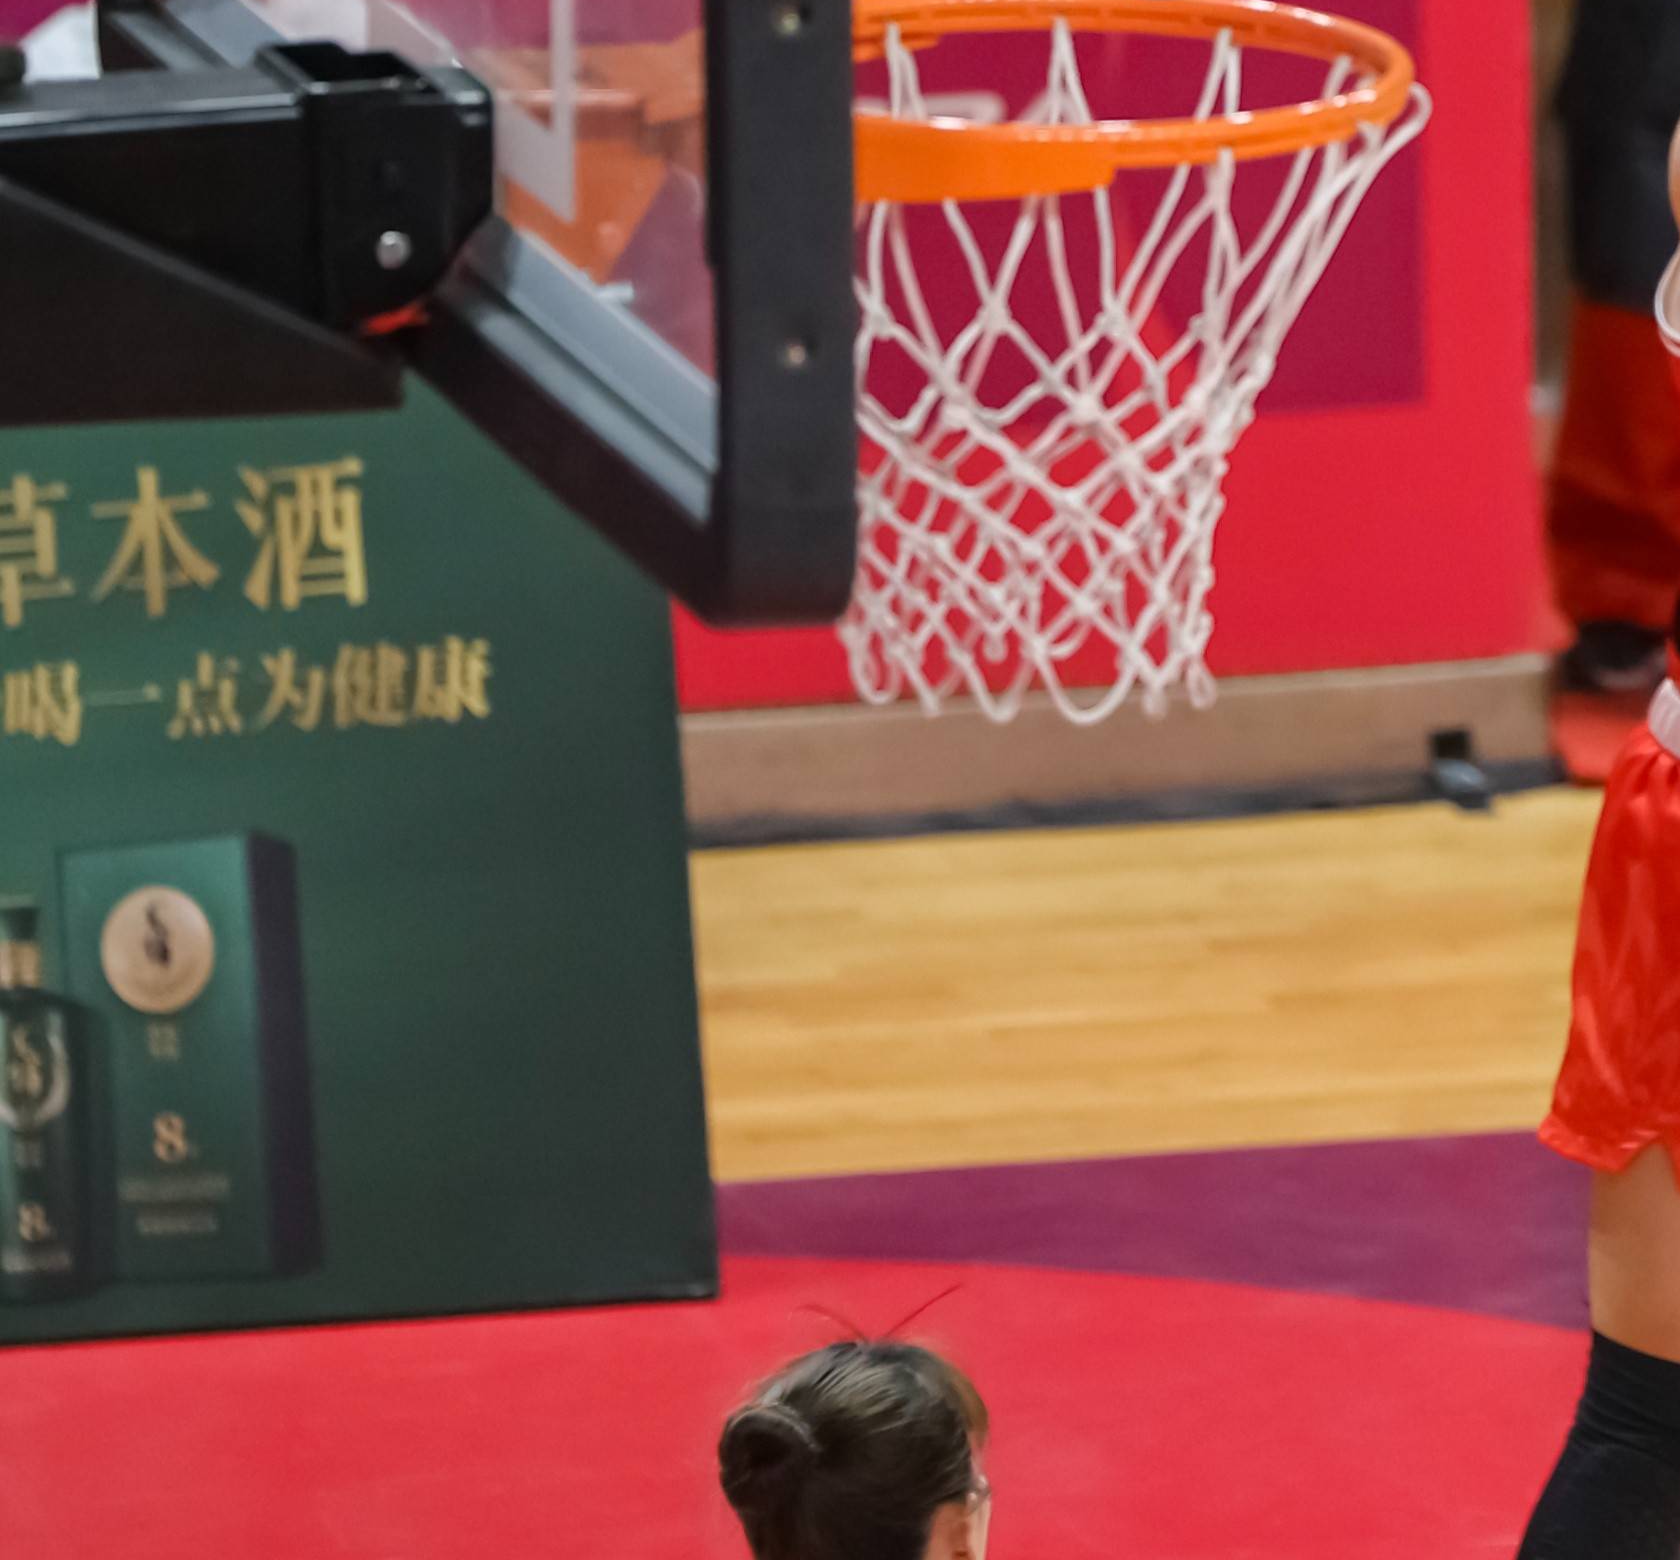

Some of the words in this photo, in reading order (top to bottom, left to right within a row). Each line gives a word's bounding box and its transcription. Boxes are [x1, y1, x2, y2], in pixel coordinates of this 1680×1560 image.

[4, 635, 492, 745] 喝一点为健康
